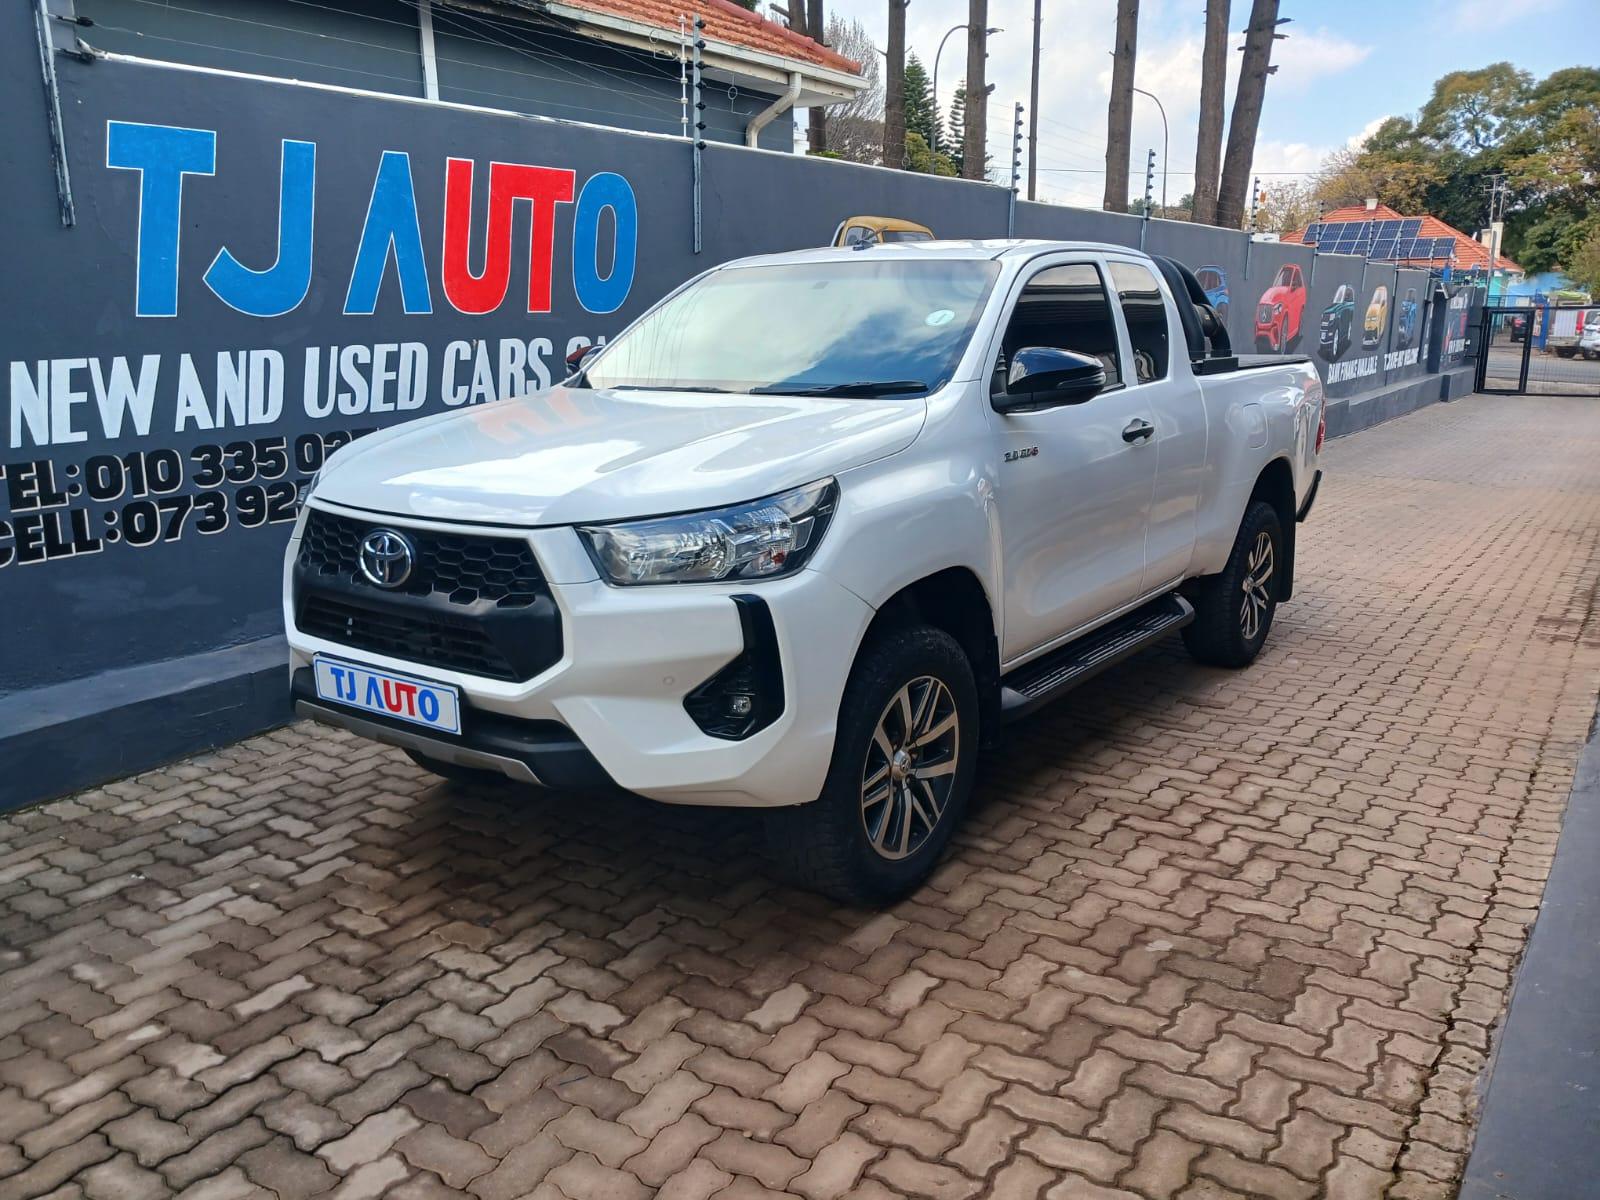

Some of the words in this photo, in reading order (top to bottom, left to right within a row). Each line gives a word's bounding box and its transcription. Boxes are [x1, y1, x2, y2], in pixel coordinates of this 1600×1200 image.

[106, 119, 316, 317] TJ
[342, 150, 637, 315] AUTO
[10, 353, 160, 448] NEW
[175, 349, 285, 432] AND
[304, 341, 428, 418] USED
[441, 336, 552, 405] CARS
[191, 436, 288, 488] 335
[236, 478, 311, 527] 92
[330, 667, 356, 701] TJ
[366, 676, 440, 722] AUTO
